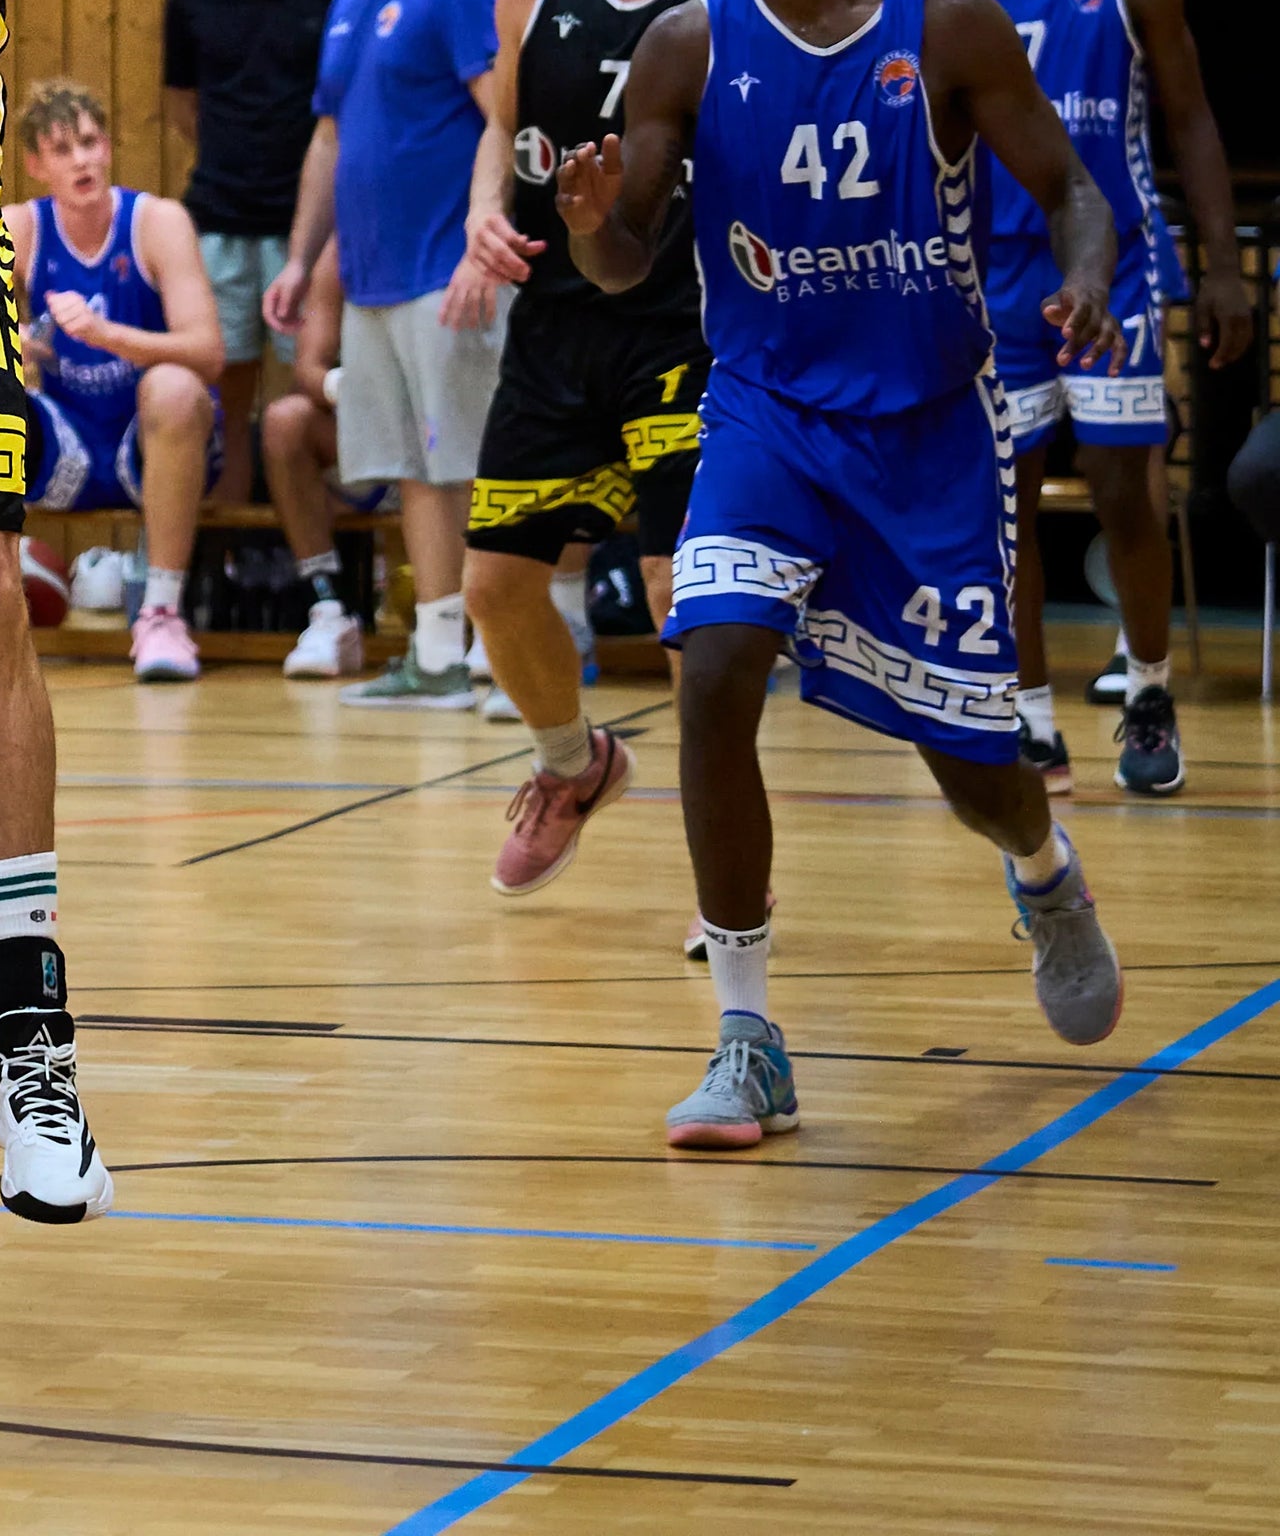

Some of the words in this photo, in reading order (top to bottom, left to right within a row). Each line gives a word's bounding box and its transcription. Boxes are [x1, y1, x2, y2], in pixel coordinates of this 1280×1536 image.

[598, 59, 631, 118] 7
[780, 120, 881, 201] 42
[1122, 313, 1146, 368] 7
[901, 585, 1001, 654] 42
